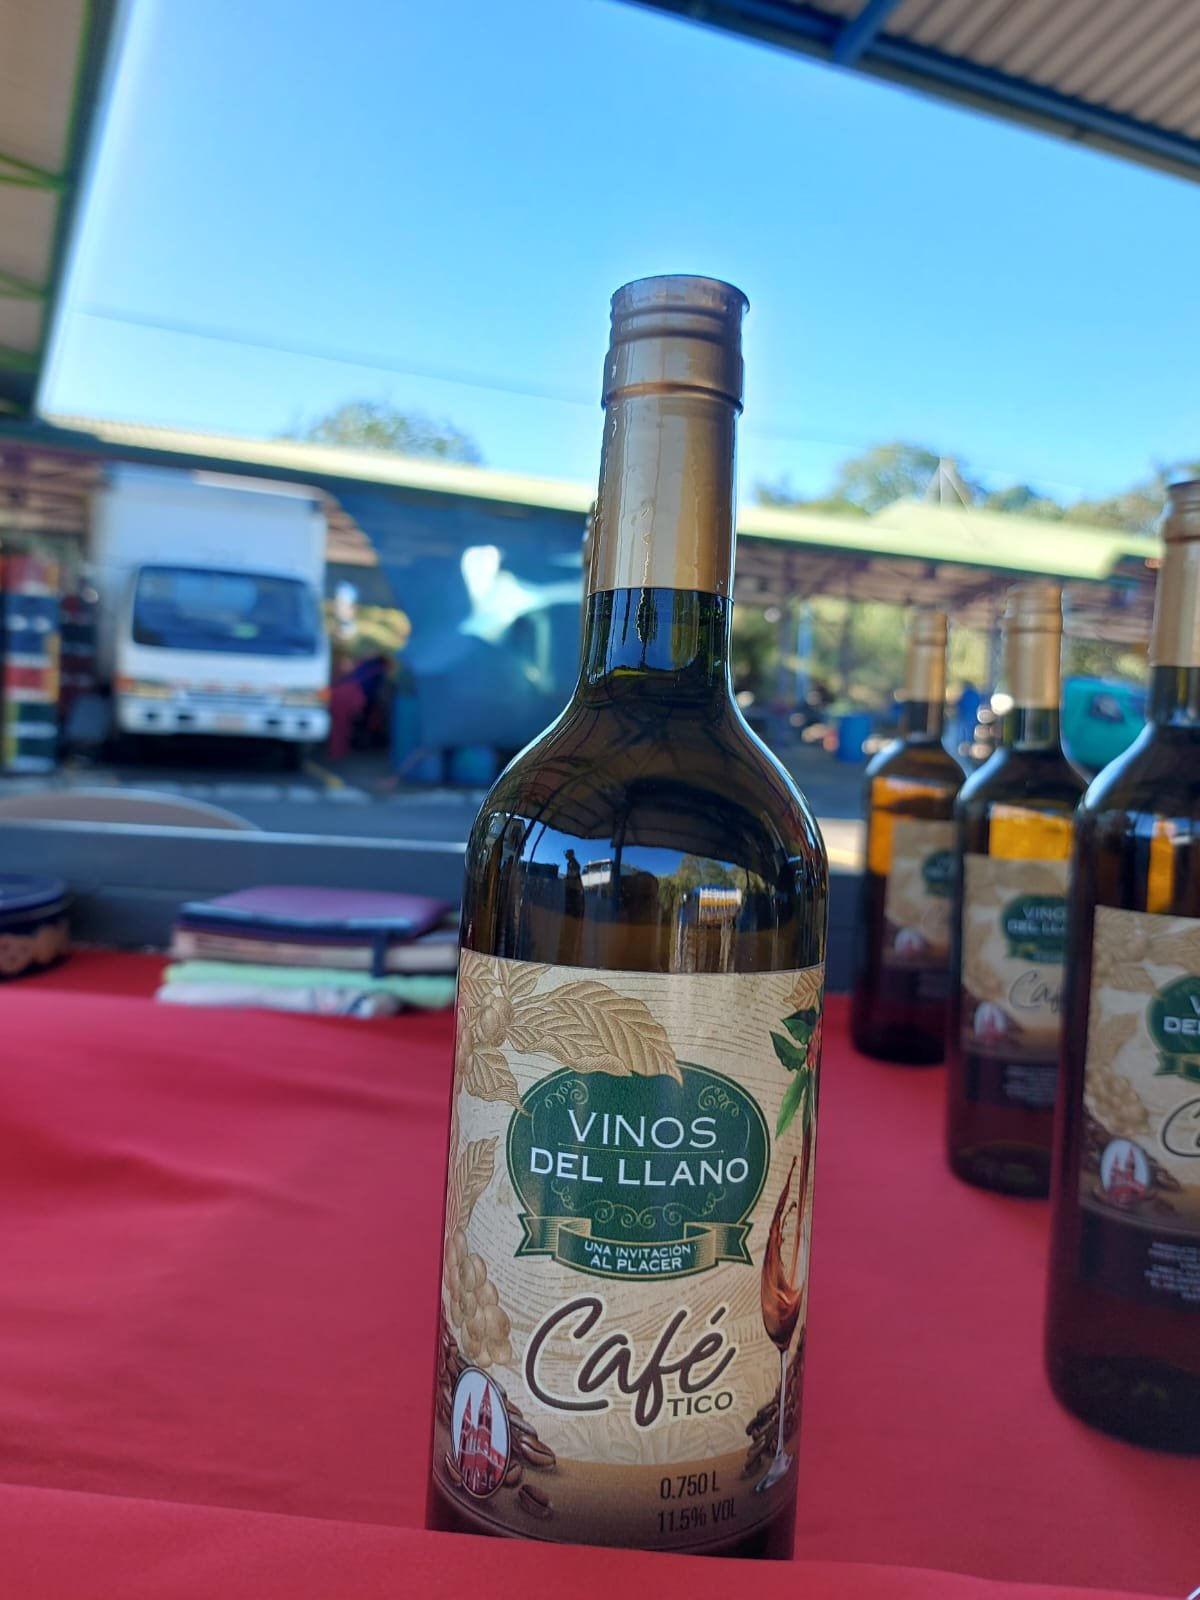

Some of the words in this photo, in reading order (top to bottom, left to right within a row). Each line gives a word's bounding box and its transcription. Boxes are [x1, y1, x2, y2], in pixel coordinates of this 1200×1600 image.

[1023, 906, 1066, 921] VINO
[1163, 1016, 1200, 1035] DE
[568, 1110, 717, 1149] VINOS
[530, 1147, 603, 1183] DEL
[617, 1157, 749, 1187] LLANO
[584, 1240, 612, 1256] UNA
[615, 1243, 691, 1259] INVITACIÓN
[590, 1254, 612, 1269] AL
[616, 1257, 682, 1272] PLACER
[525, 1297, 736, 1427] Café
[667, 1391, 733, 1416] TICO
[660, 1472, 708, 1500] 0.750
[711, 1470, 720, 1492] L
[658, 1504, 707, 1533] 11.5%
[711, 1497, 737, 1524] VOL
